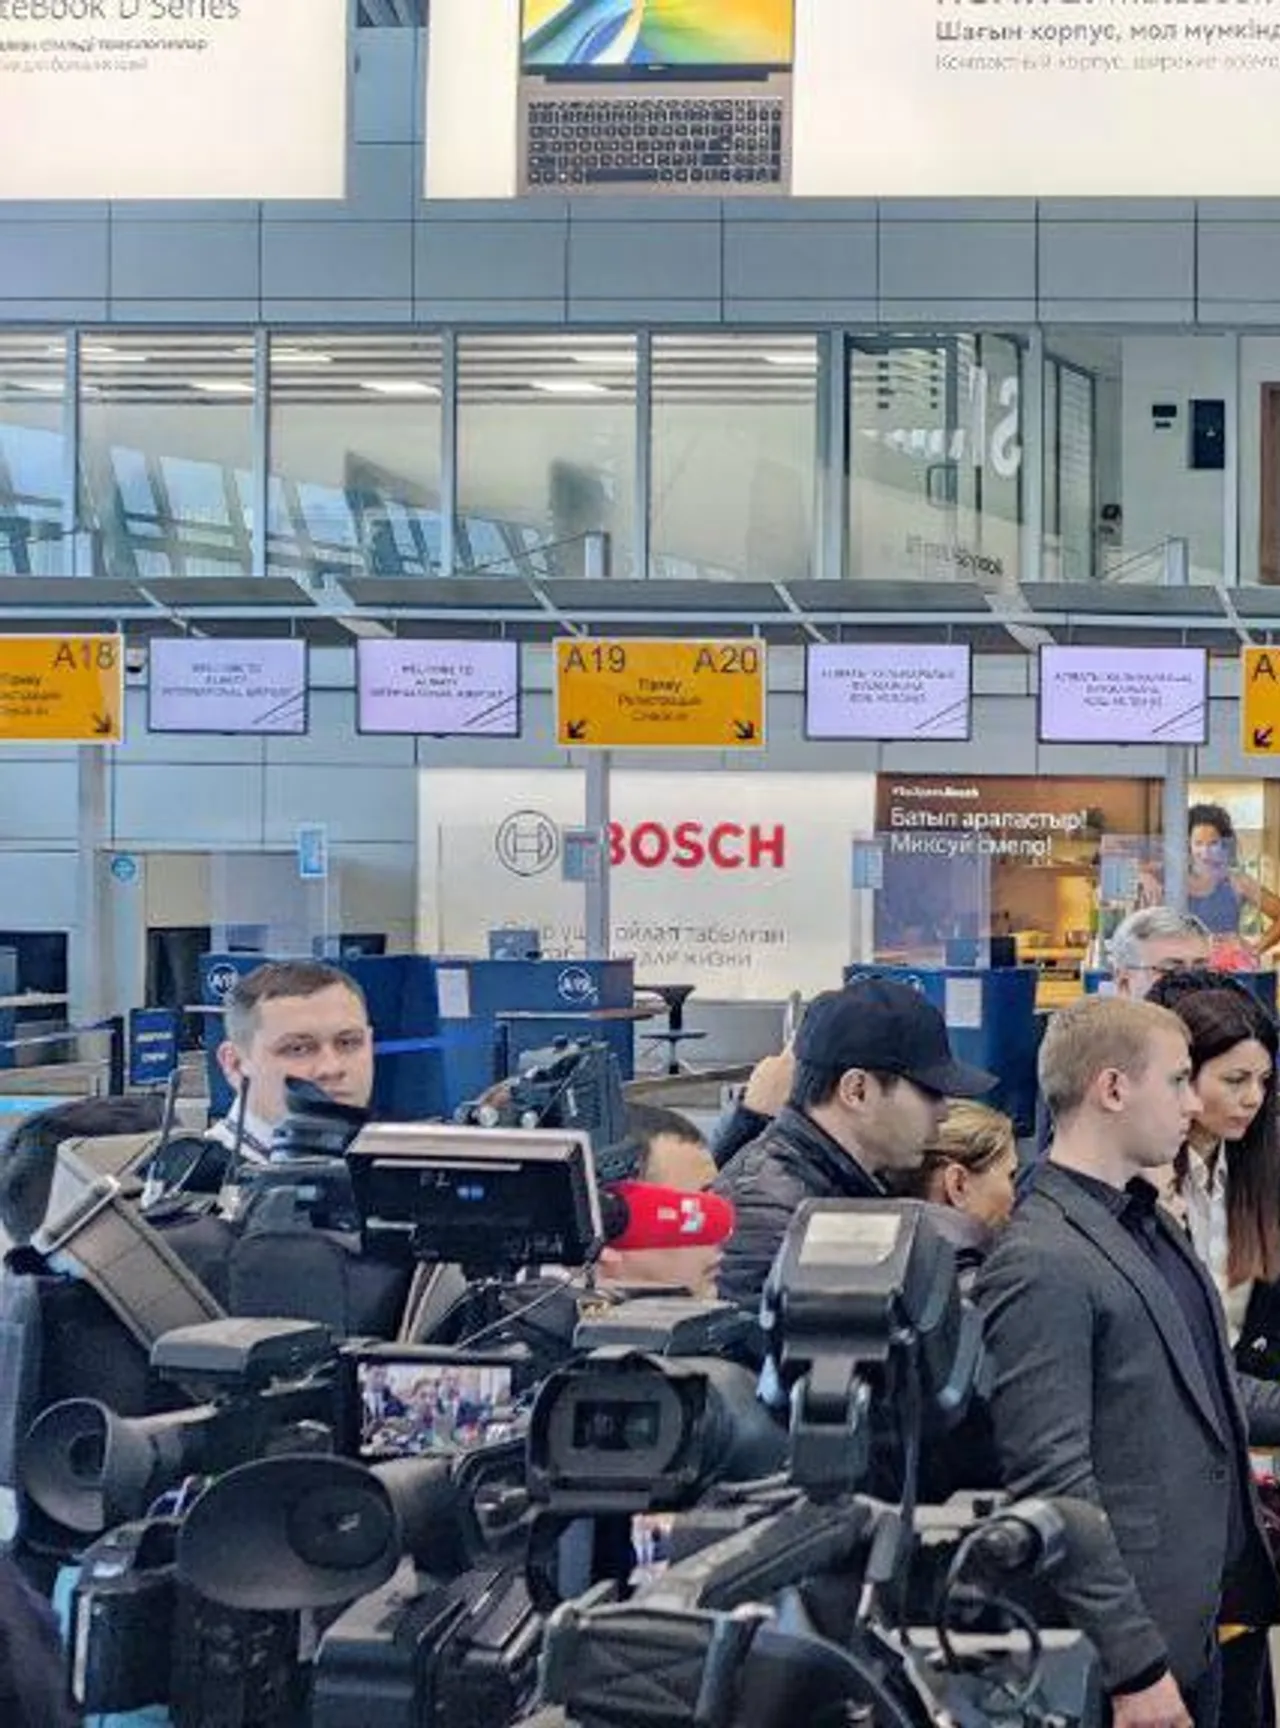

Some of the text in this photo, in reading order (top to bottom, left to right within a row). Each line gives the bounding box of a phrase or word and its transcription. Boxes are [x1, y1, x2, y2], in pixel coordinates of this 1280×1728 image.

[936, 19, 1022, 41] Шағын
[1030, 22, 1122, 46] корпус,
[1131, 23, 1178, 40] мол
[54, 642, 114, 669] A18
[564, 647, 758, 675] A19 A20
[890, 806, 1088, 832] Батыл араластыр!
[978, 836, 1052, 858] смело!
